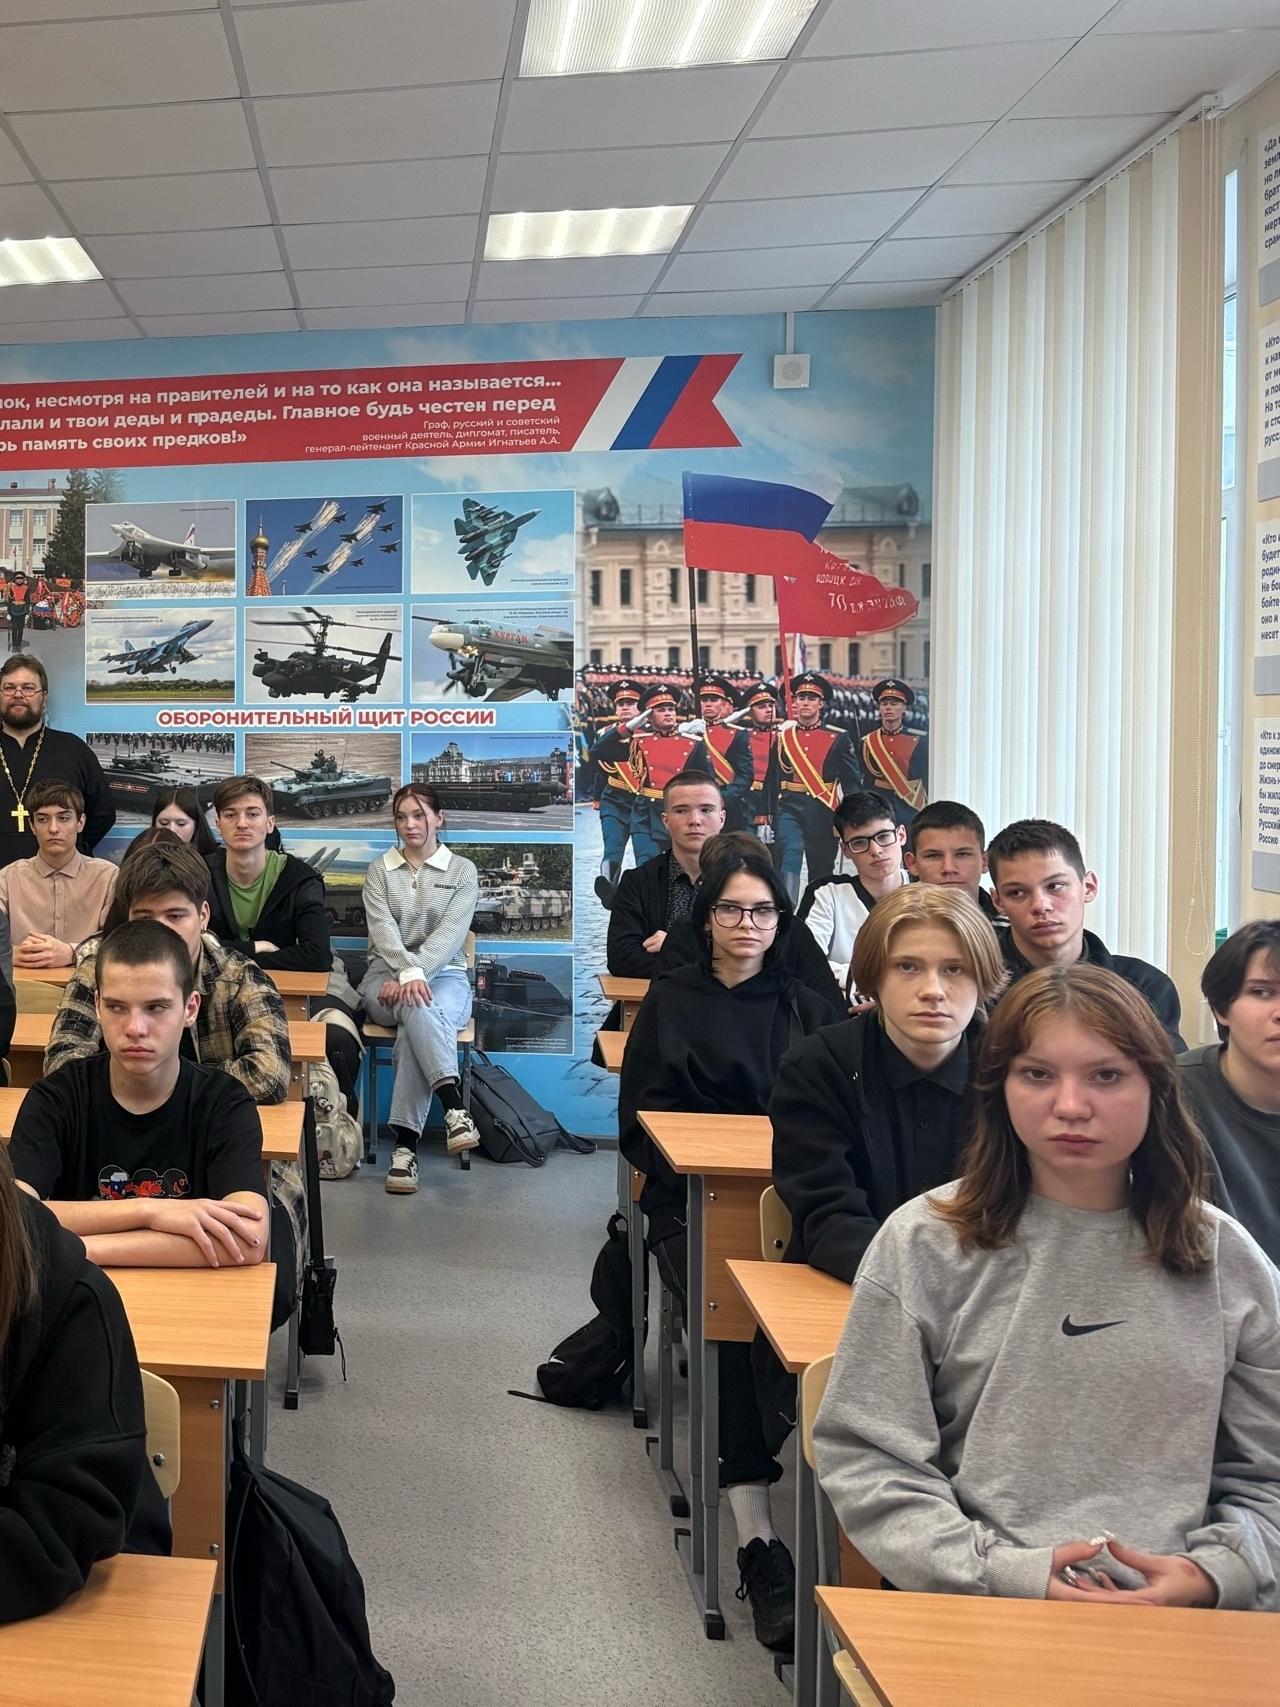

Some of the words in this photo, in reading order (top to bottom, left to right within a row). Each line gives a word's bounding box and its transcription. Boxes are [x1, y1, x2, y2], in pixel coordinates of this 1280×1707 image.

[35, 393, 124, 408] несмотря
[130, 393, 151, 404] на
[157, 384, 268, 405] правителей
[274, 386, 286, 397] и
[292, 385, 314, 397] на
[320, 384, 342, 395] то
[347, 382, 382, 394] как
[387, 380, 423, 393] она
[429, 376, 561, 391] называется...
[49, 418, 61, 429] и
[66, 416, 109, 428] твои
[114, 413, 164, 428] деды
[171, 413, 182, 424] и
[187, 409, 277, 426] прадеды.
[282, 404, 360, 420] Главное
[366, 401, 414, 419] будь
[419, 400, 487, 413] честен
[493, 398, 556, 413] перед
[423, 421, 450, 431] Граф,
[453, 419, 494, 431] русский
[496, 419, 503, 427] и
[506, 416, 560, 427] советский
[22, 438, 88, 451] память
[92, 436, 147, 449] своих
[152, 430, 248, 450] предков!»
[362, 431, 407, 441] военный
[410, 430, 453, 441] деятель,
[510, 427, 560, 438] писатель,
[305, 441, 402, 454] генерал-лейтенант
[405, 440, 449, 451] Красной
[452, 440, 486, 450] Армии
[489, 437, 537, 448] Игнатьев
[494, 630, 529, 643] КУРГАН
[159, 706, 352, 726] ОБОРОНИТЕЛЬНЫЙ
[359, 710, 404, 728] ЩИТ
[411, 710, 494, 725] РОССИИ
